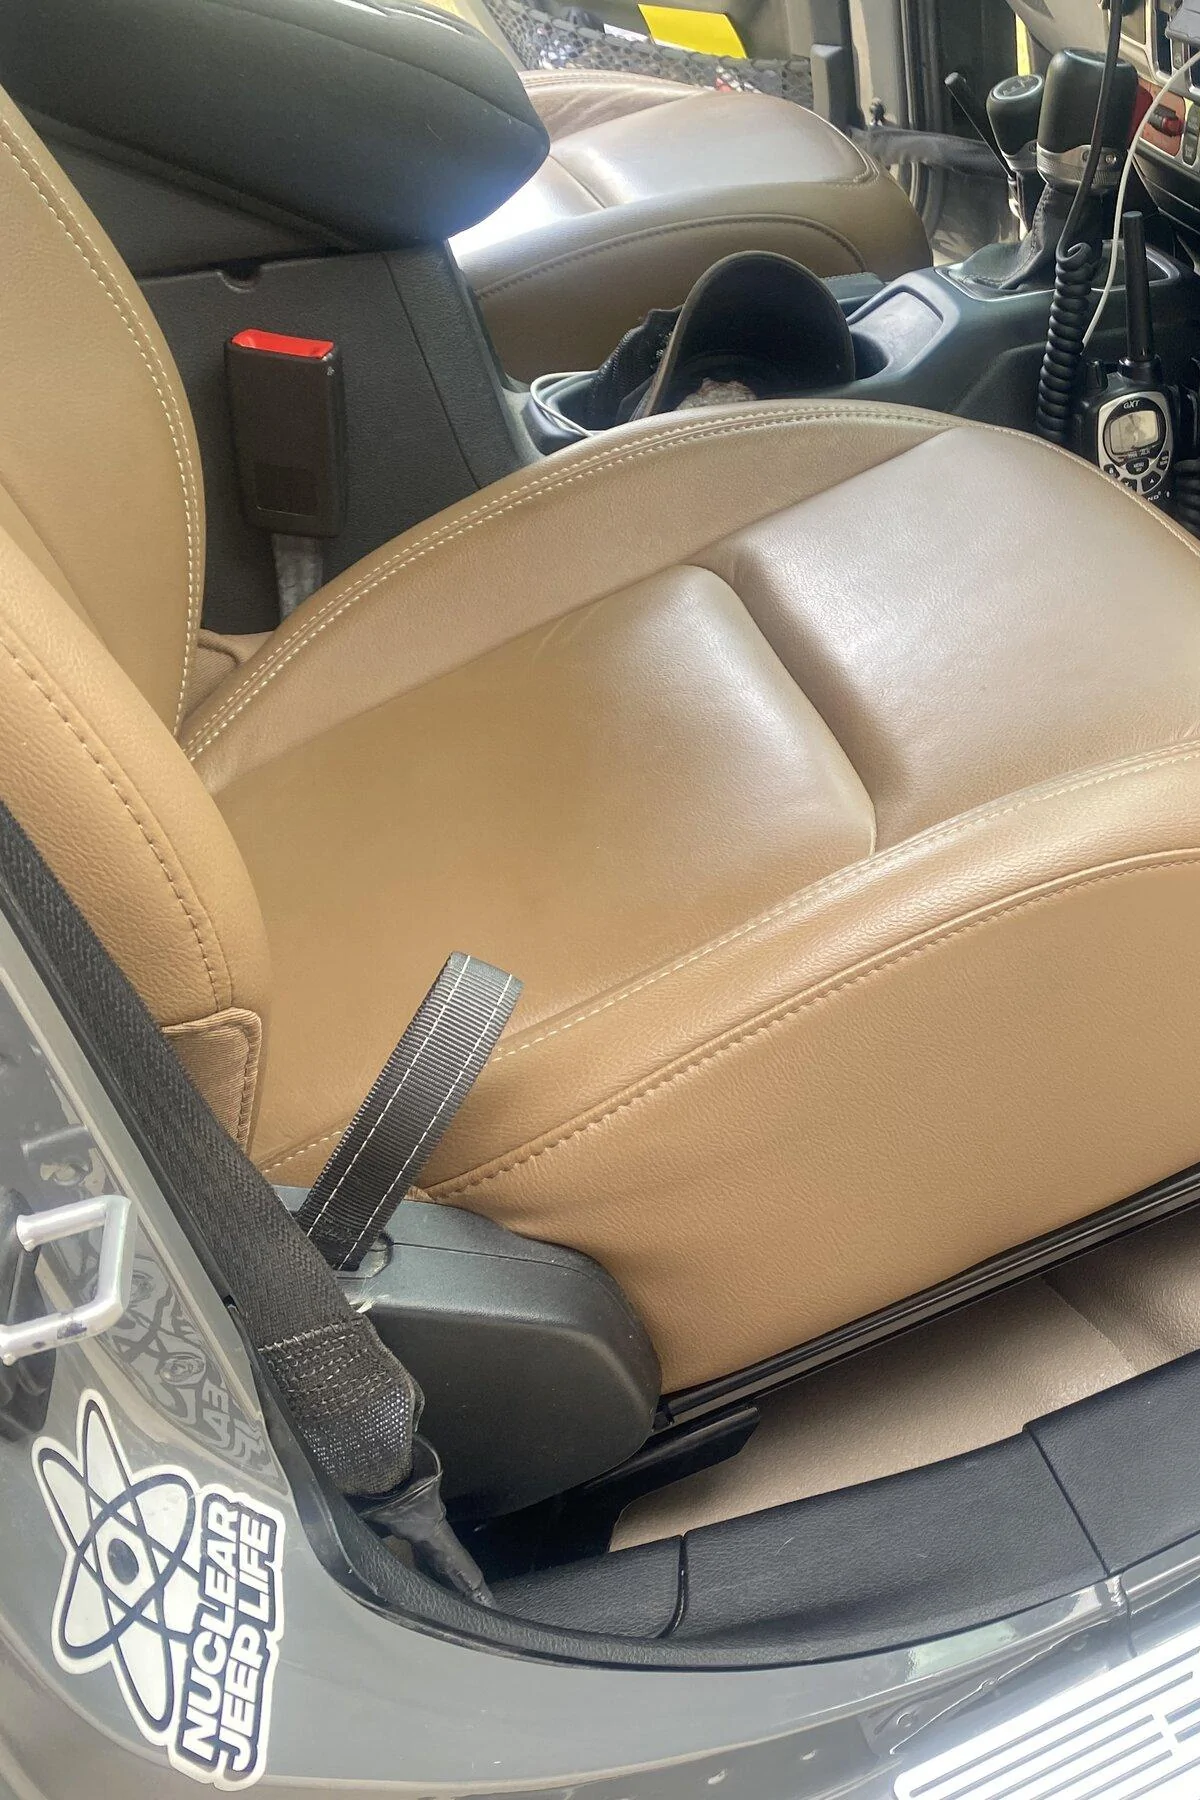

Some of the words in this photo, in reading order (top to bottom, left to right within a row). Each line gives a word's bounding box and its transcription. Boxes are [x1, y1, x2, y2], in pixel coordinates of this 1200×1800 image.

[1123, 399, 1140, 409] GXT
[182, 1500, 238, 1762] NUCLEAR
[238, 1513, 270, 1624] LIFE
[219, 1623, 264, 1772] JEEP
